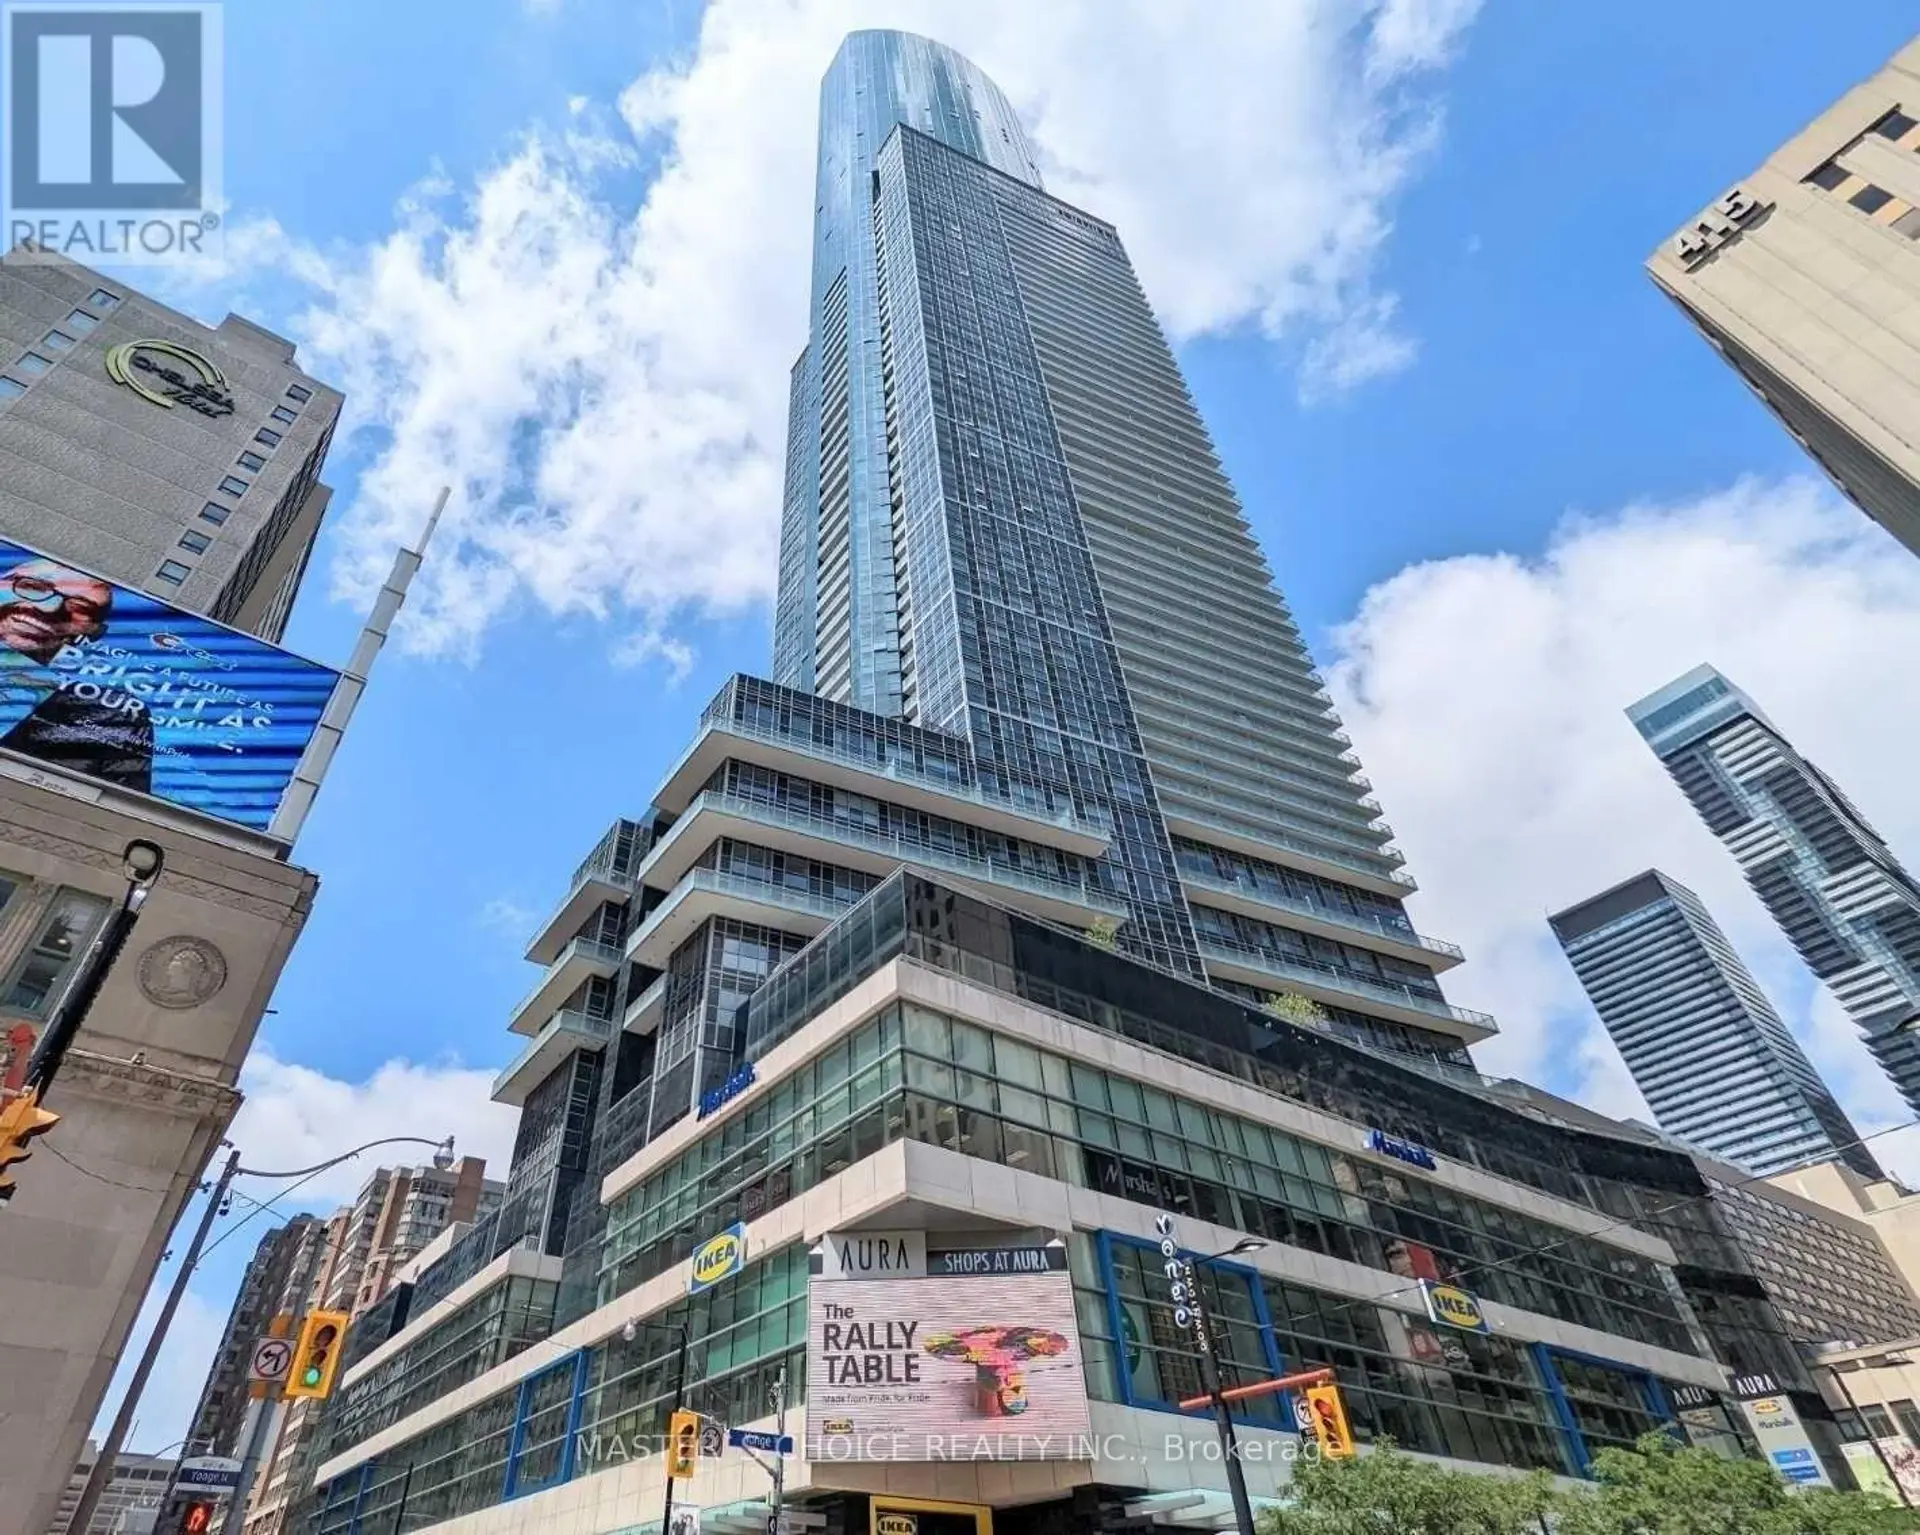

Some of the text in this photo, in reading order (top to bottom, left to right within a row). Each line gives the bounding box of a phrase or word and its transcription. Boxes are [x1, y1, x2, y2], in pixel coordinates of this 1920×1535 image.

[1675, 187, 1760, 258] 415
[49, 643, 217, 714] BRIGHT
[217, 708, 273, 730] AS
[55, 671, 145, 722] YOUR
[160, 666, 177, 679] A
[179, 672, 250, 706] FUTURE
[249, 700, 275, 714] AS
[1105, 1163, 1172, 1200] Mrshas
[696, 1241, 736, 1275] IKEA
[841, 1238, 910, 1273] AURA
[944, 1250, 1050, 1273] SHOPS AT AURA
[823, 1304, 855, 1320] The
[1433, 1292, 1480, 1319] IKEA
[823, 1321, 919, 1351] RALLY
[822, 1354, 921, 1384] TABLE
[1735, 1373, 1778, 1396] AURA
[881, 1520, 914, 1533] IKEA
